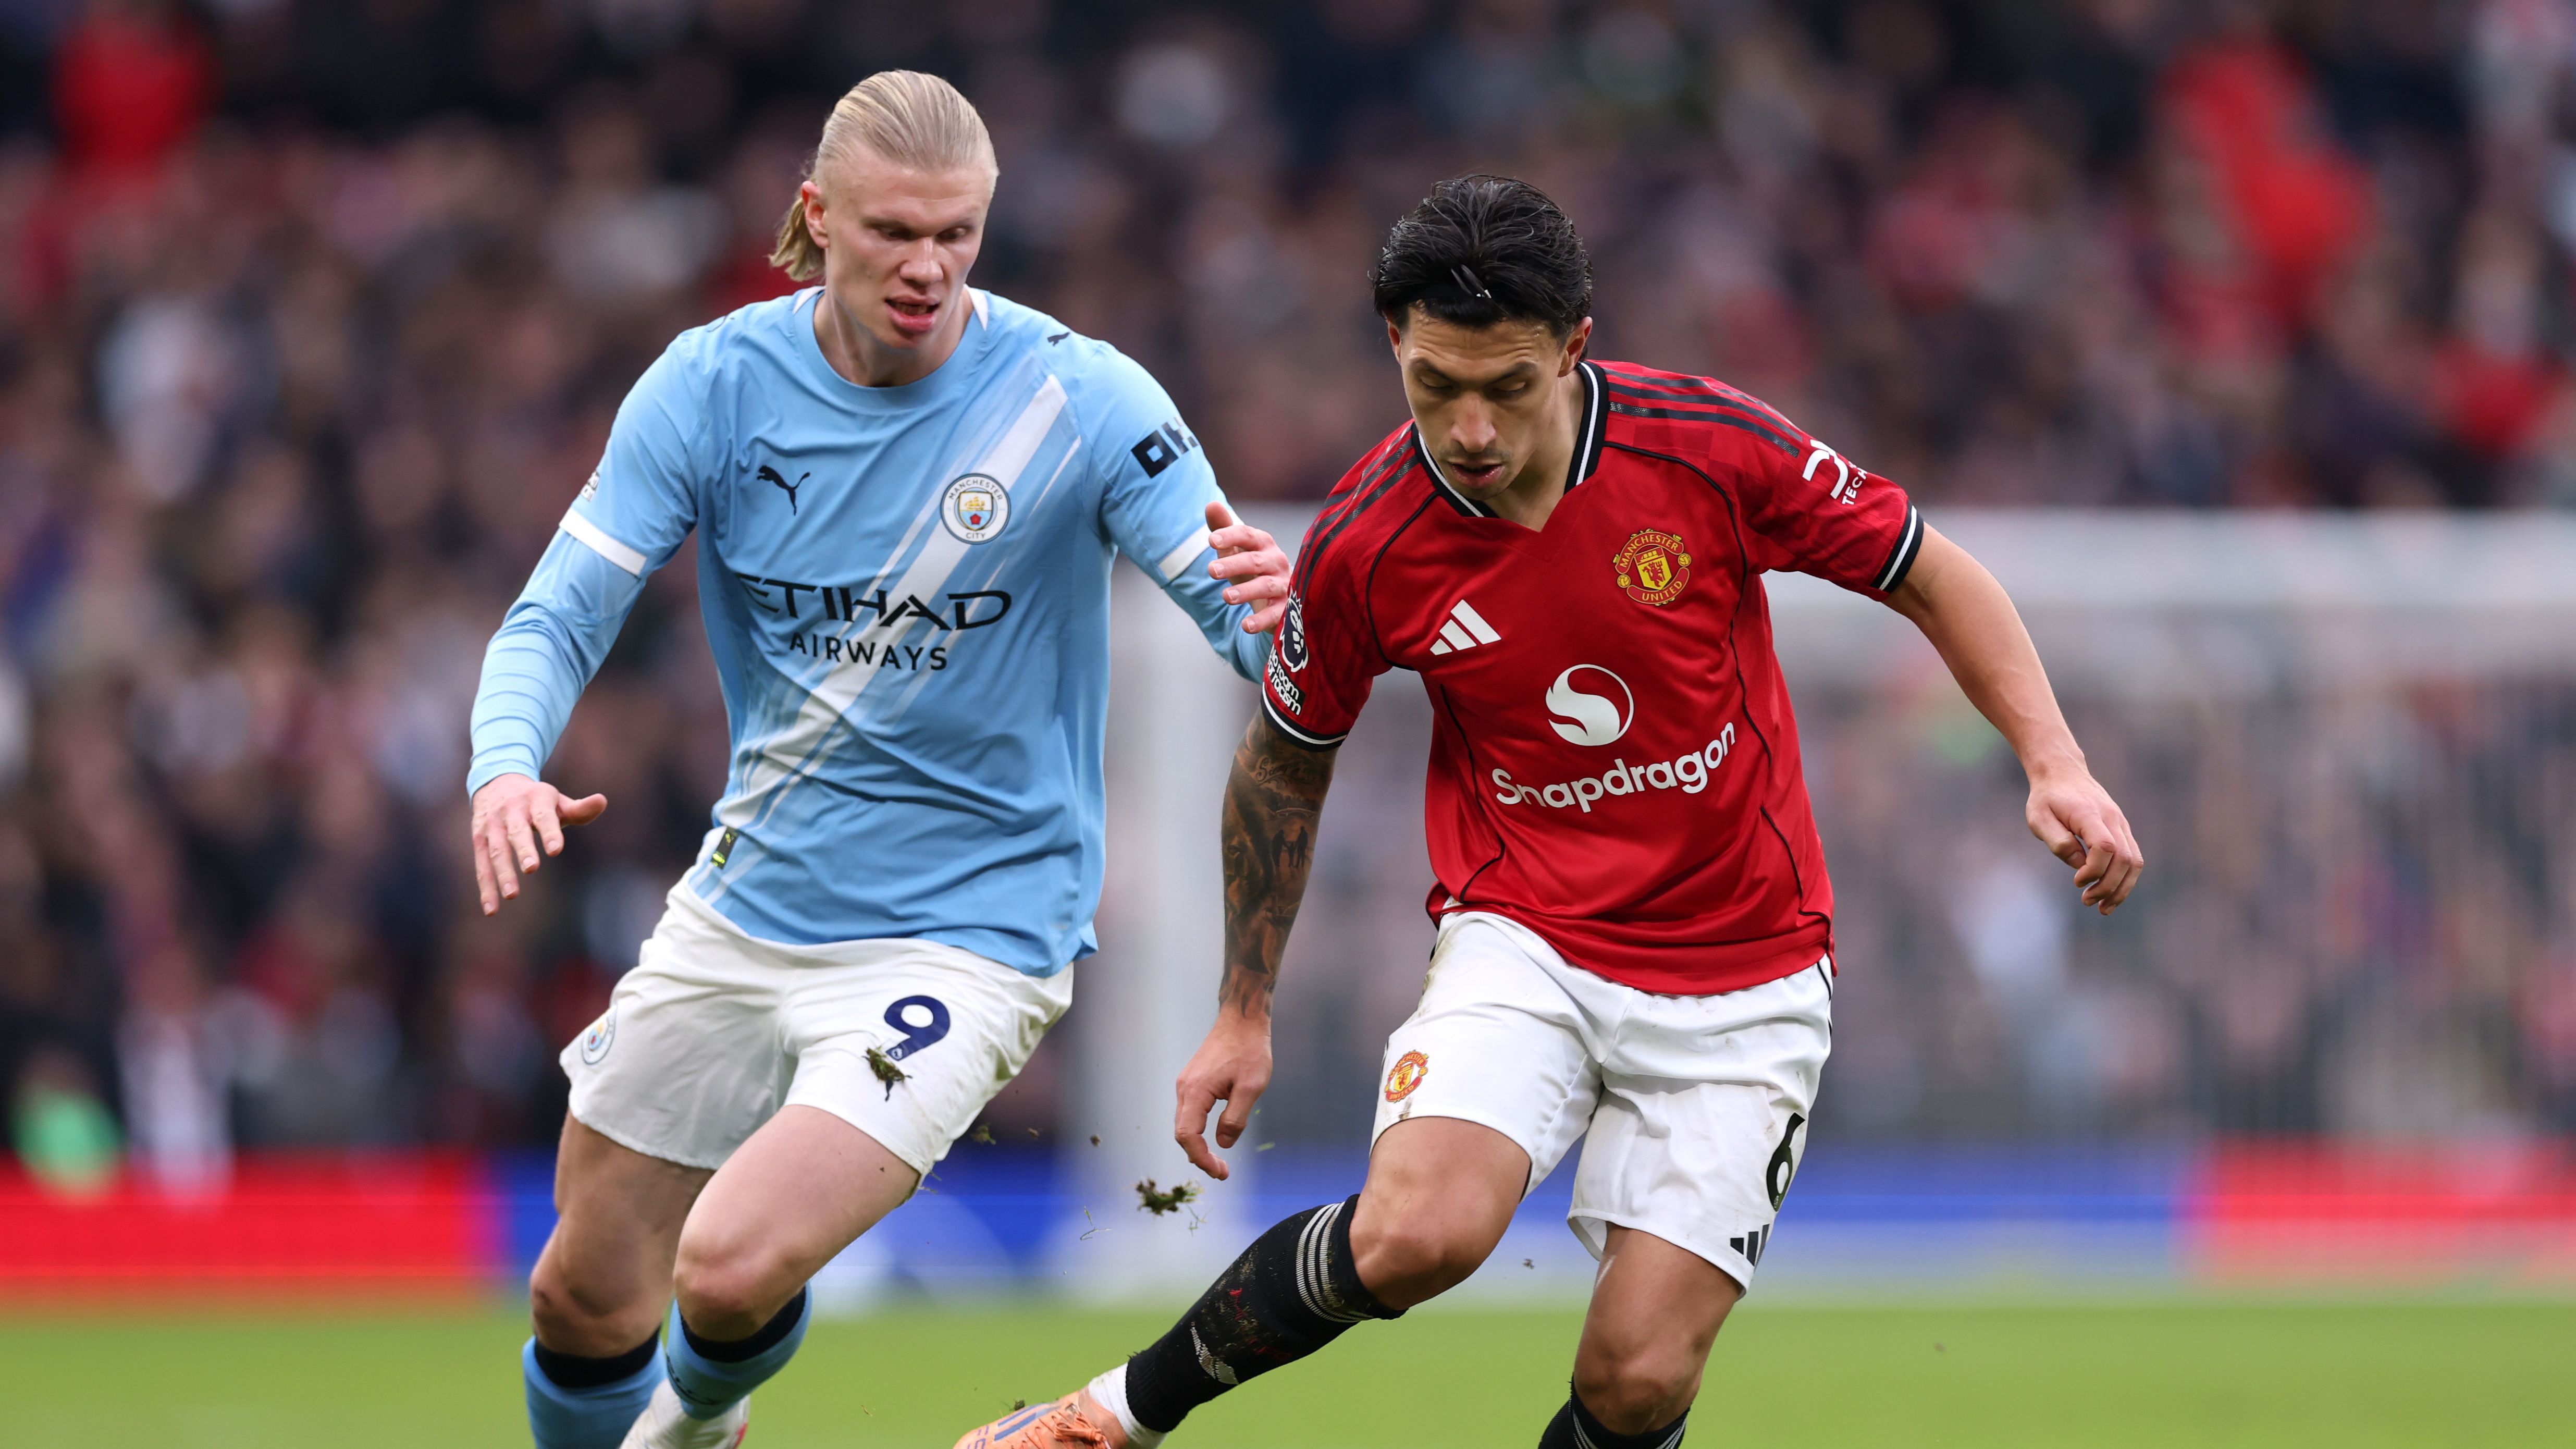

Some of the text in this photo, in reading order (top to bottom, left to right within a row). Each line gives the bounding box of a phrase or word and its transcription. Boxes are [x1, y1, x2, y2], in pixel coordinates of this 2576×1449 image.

[949, 479, 1003, 501] MANCHESTER
[1620, 534, 1679, 568] MANCHESTER
[734, 572, 1012, 631] ETIHAD
[1642, 581, 1683, 601] UNITED
[789, 632, 947, 671] AIRWAYS
[1272, 673, 1301, 716] racism
[1276, 663, 1299, 701] room
[1492, 722, 1735, 813] Snapdragon
[884, 995, 950, 1061] 9
[1766, 1112, 1806, 1212] 6
